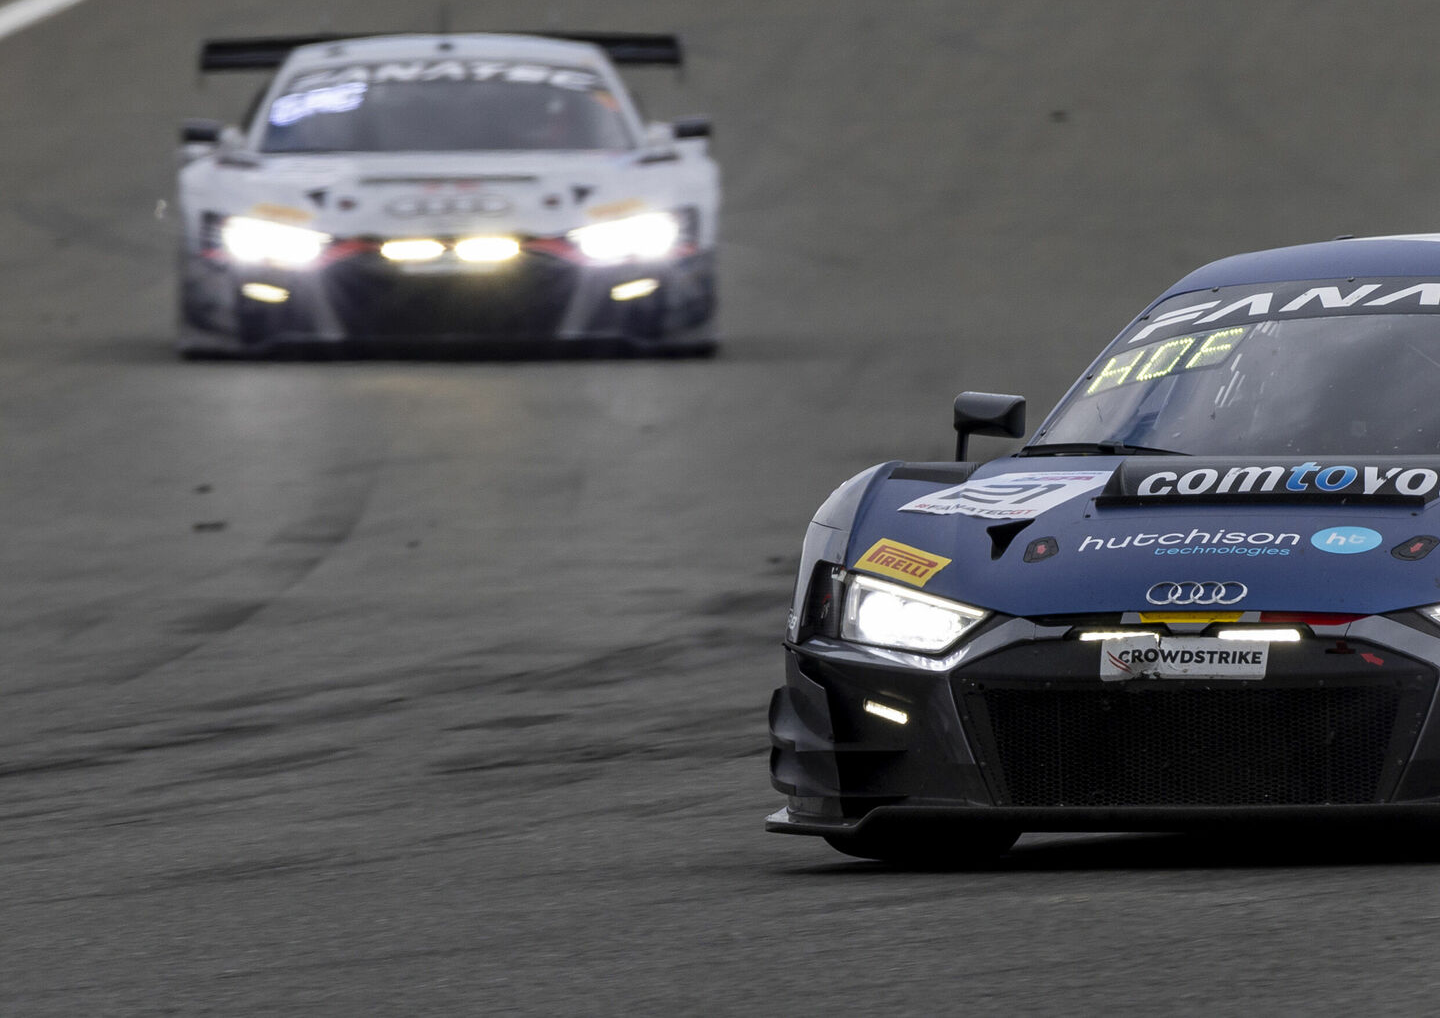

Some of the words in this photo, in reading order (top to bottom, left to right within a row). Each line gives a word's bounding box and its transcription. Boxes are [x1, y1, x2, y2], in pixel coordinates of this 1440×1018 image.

[1086, 327, 1245, 397] HOF
[1078, 528, 1300, 552] hutchison
[1326, 531, 1369, 546] ht
[866, 544, 938, 579] PIRELLI
[1153, 547, 1291, 557] technologies
[1118, 648, 1263, 665] CROWDSTRIKE
